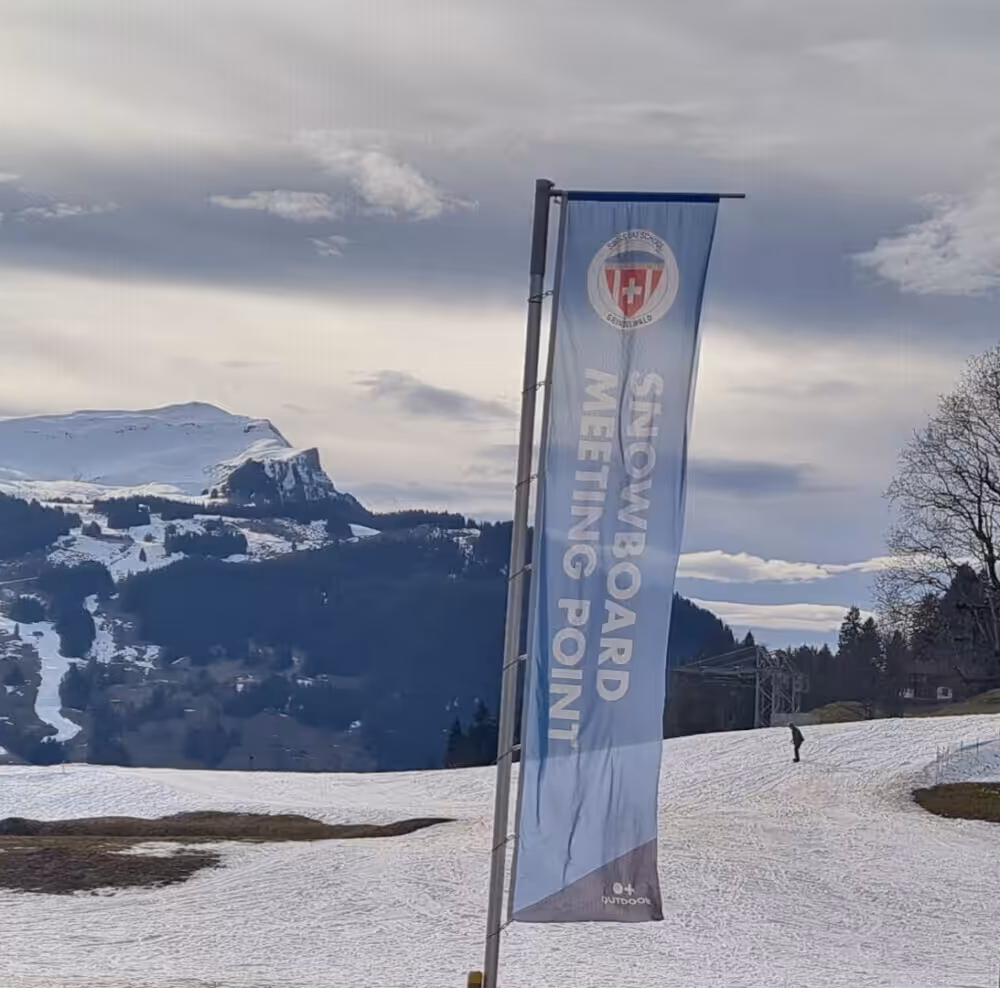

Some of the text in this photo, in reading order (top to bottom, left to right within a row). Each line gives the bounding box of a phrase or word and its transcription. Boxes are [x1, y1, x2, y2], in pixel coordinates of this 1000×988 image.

[549, 368, 618, 749] MEETING POINT
[596, 370, 664, 702] SNOWBOARD
